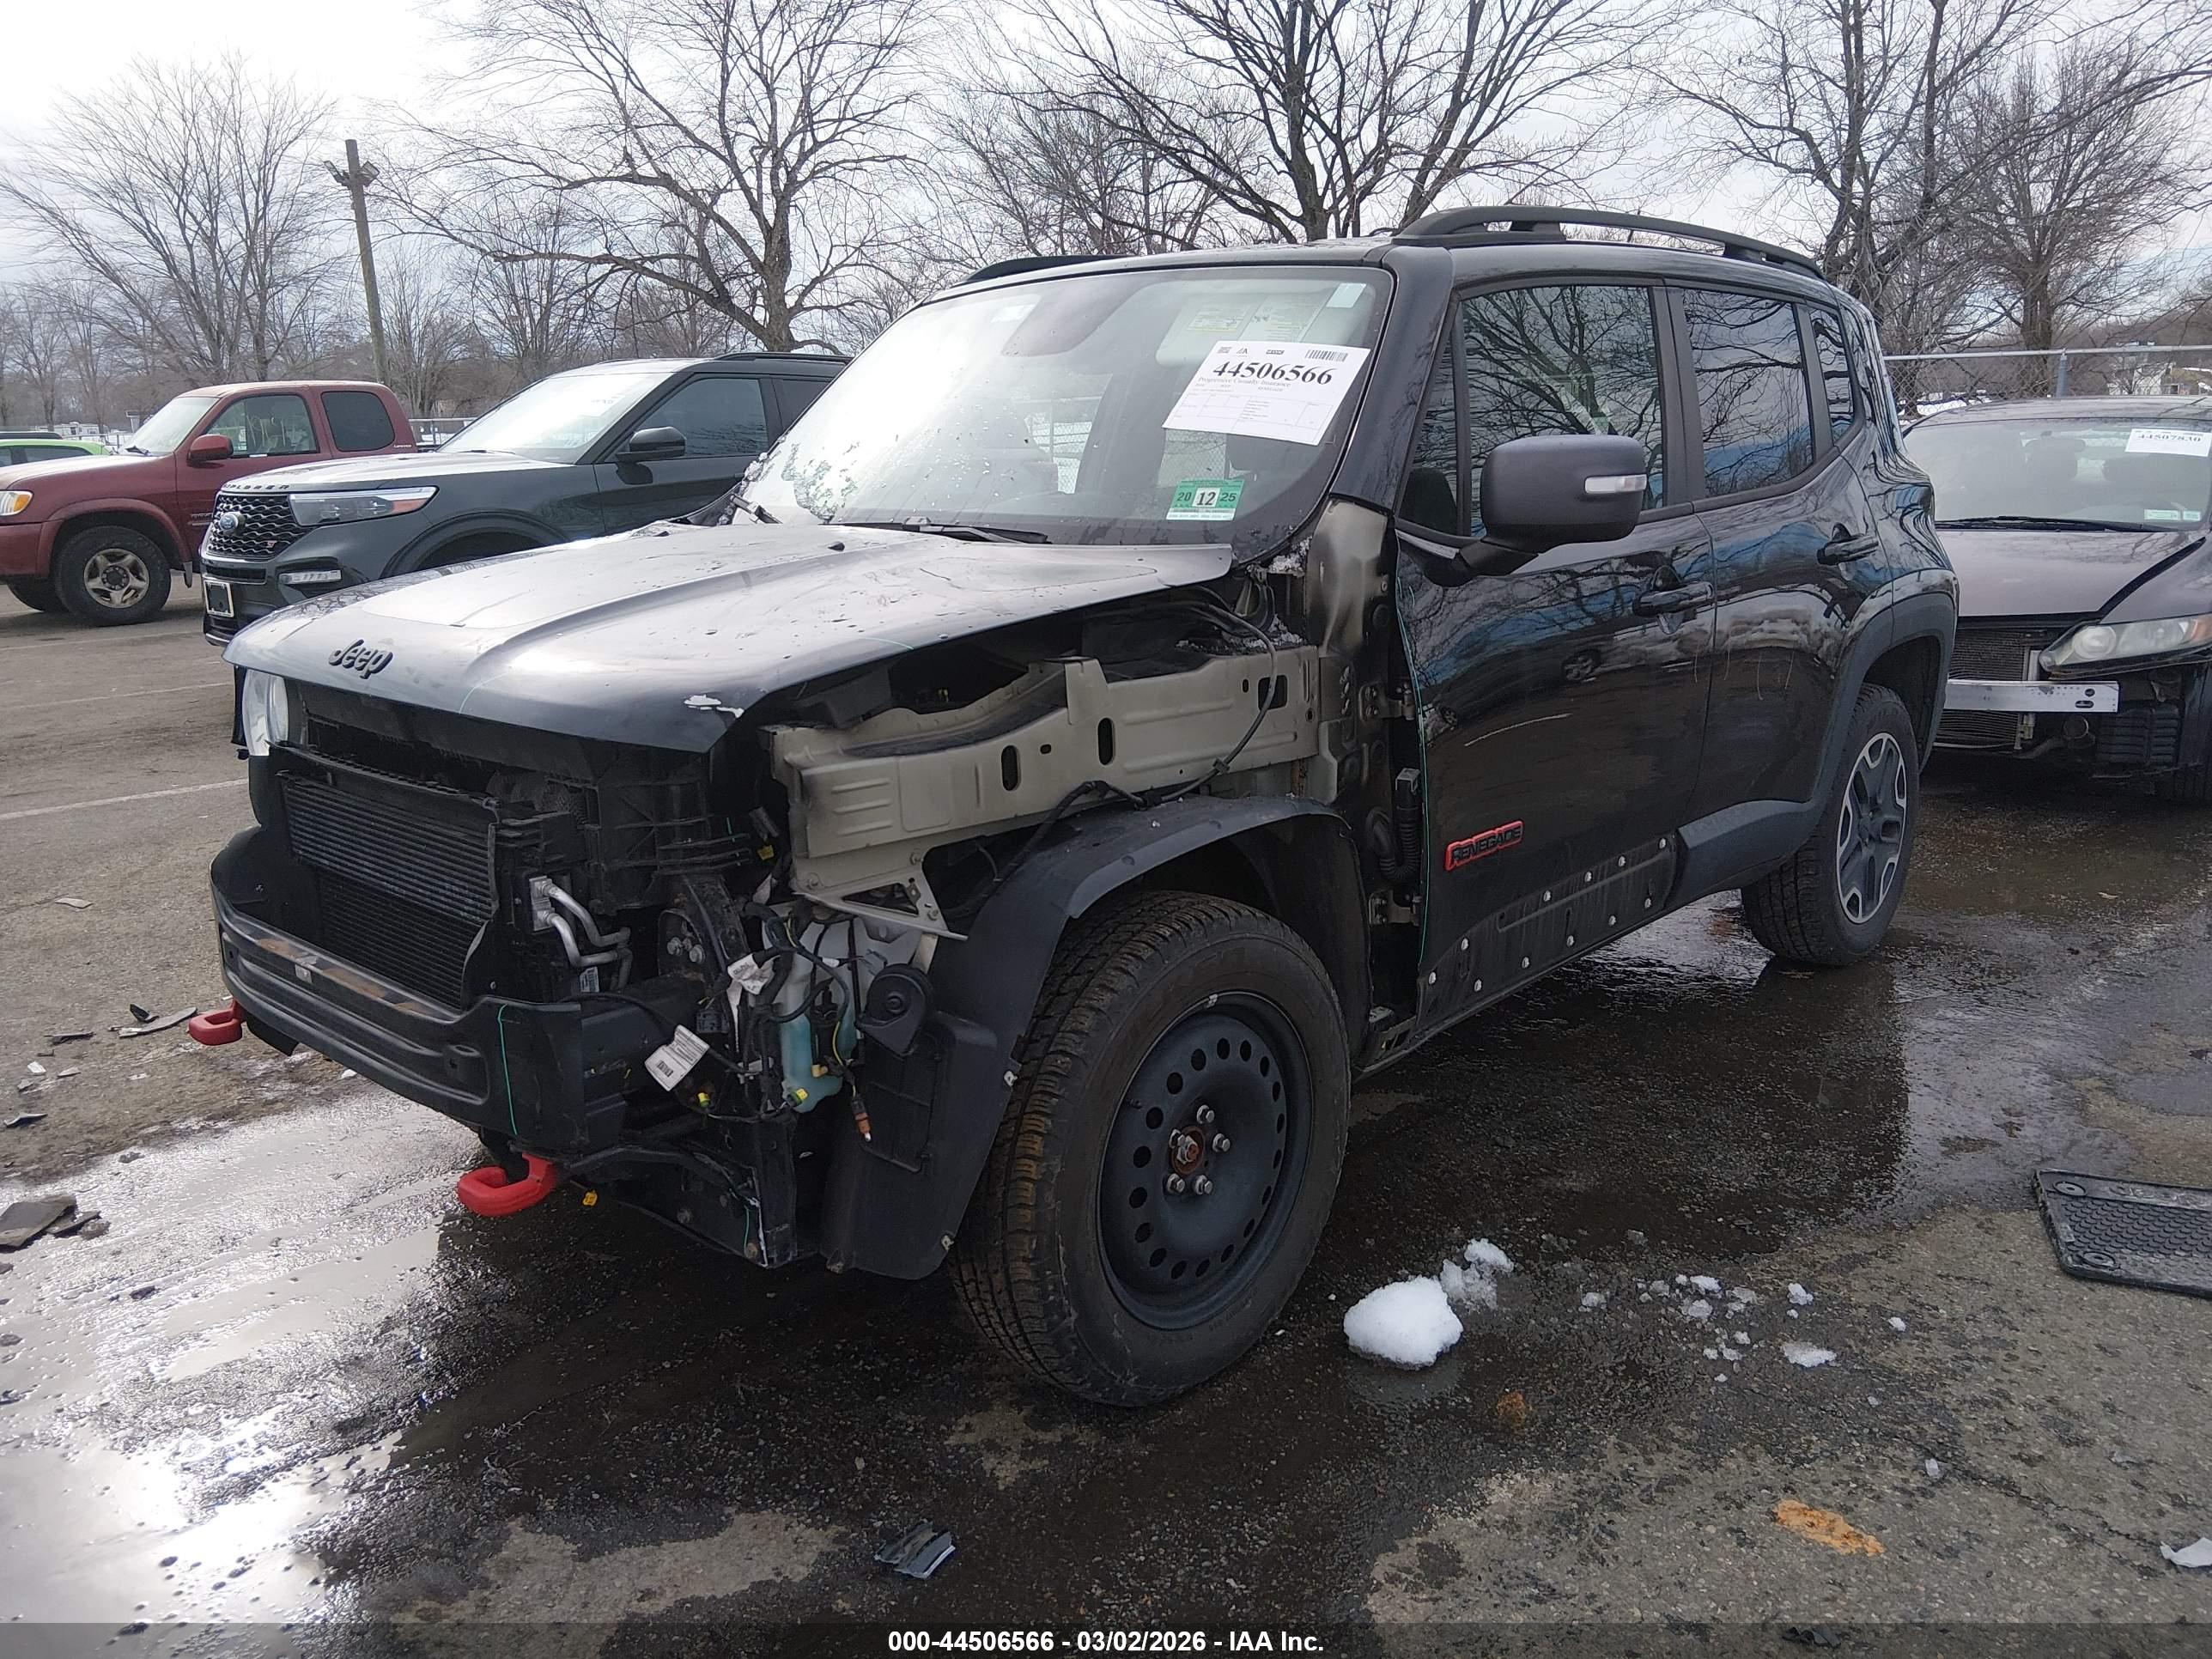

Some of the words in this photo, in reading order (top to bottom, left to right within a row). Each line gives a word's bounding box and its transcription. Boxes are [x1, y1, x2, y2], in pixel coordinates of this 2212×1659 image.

[1212, 361, 1337, 386] 44506566
[1176, 491, 1192, 501] 20
[1196, 491, 1217, 506] 12
[1219, 492, 1237, 501] 25
[328, 638, 394, 680] Jeep
[1449, 824, 1522, 864] RENEGADE
